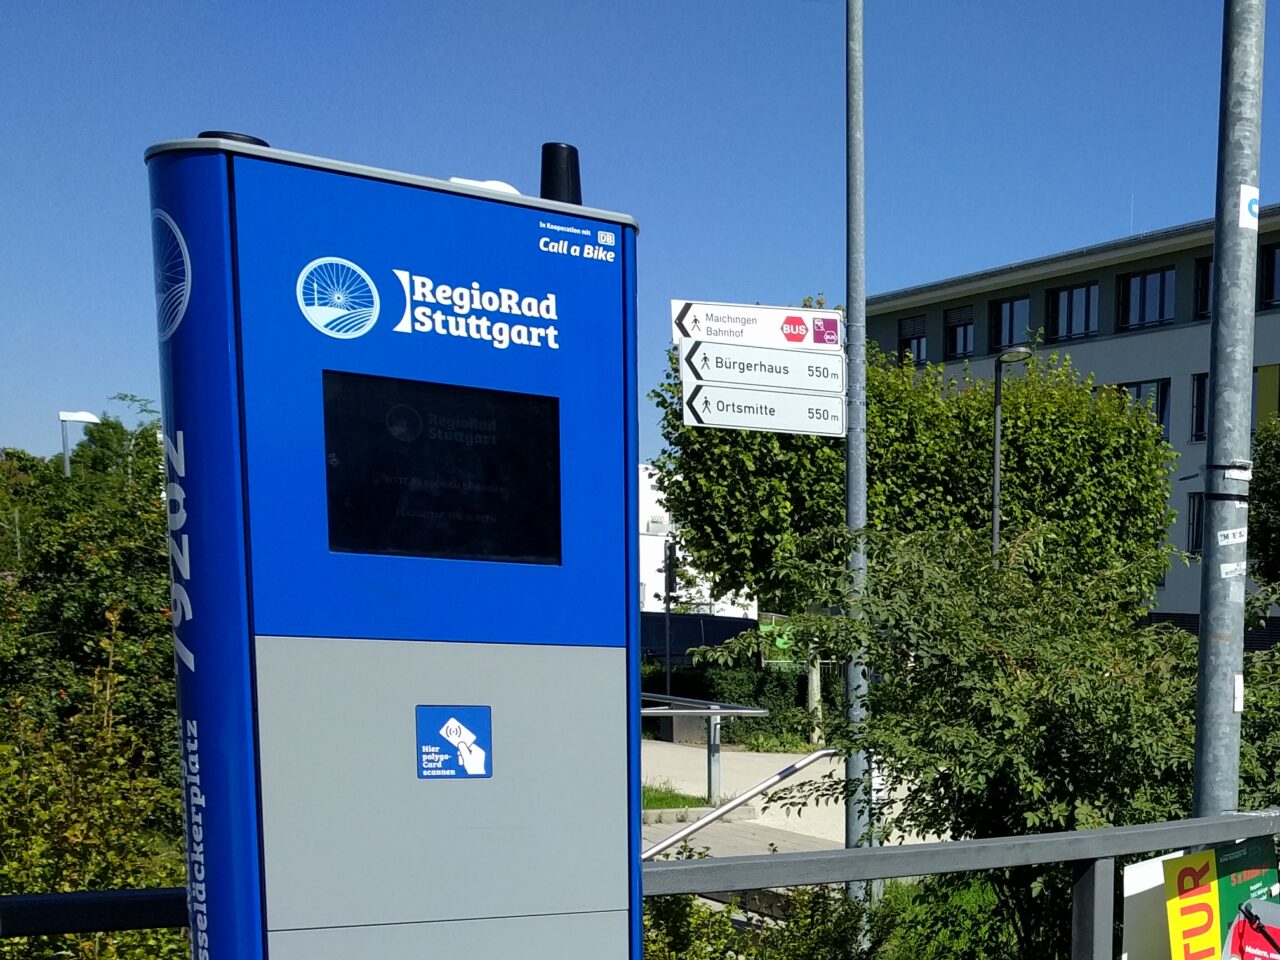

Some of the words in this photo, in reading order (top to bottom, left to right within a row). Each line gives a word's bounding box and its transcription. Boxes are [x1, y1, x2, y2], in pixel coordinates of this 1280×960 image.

[539, 237, 568, 255] Call
[570, 245, 580, 257] a
[583, 244, 615, 262] Bike
[599, 232, 614, 245] DB
[412, 275, 558, 320] RegioRad
[414, 306, 559, 349] Stuttgart
[705, 313, 757, 325] Maichingen
[783, 324, 806, 335] BUS
[706, 327, 744, 338] Bahnhof
[715, 356, 790, 375] Bürgerhaus
[807, 365, 829, 378] 550
[831, 372, 839, 380] m
[716, 400, 776, 416] Ortsmitte
[807, 408, 829, 420] 550
[831, 414, 839, 422] m
